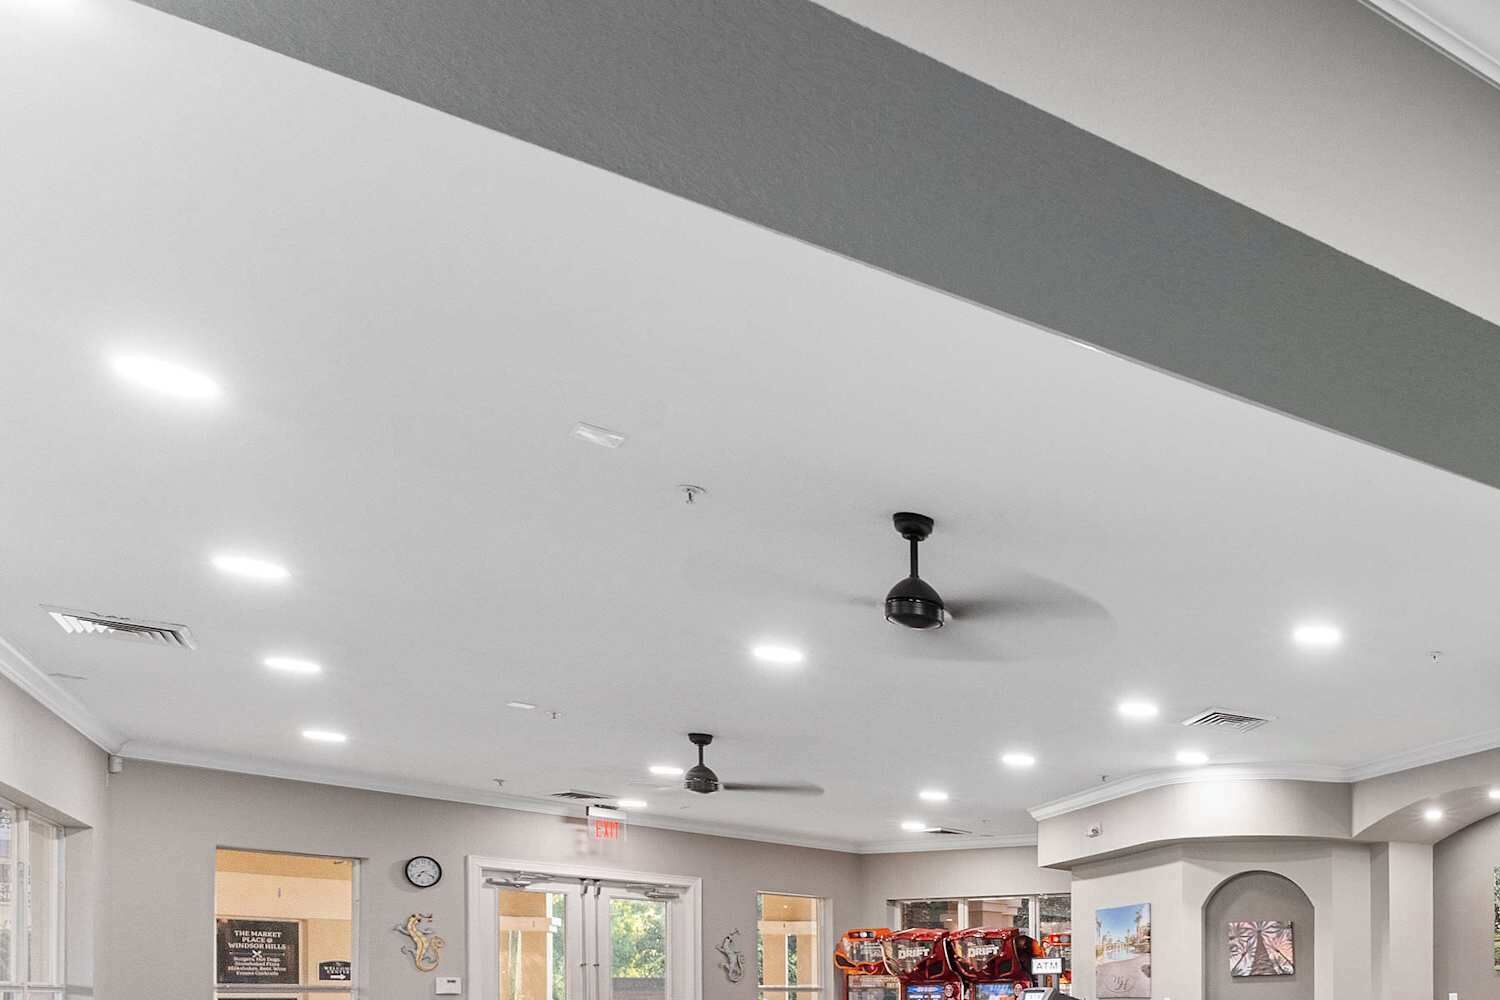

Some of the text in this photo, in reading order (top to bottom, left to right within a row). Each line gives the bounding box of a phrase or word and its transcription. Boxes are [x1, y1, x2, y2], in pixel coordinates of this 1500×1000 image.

[594, 819, 620, 840] EXIT
[228, 942, 265, 950] WINDSOR
[898, 948, 930, 959] DRIFT
[967, 946, 999, 958] DRIFT
[1036, 961, 1059, 970] ATM
